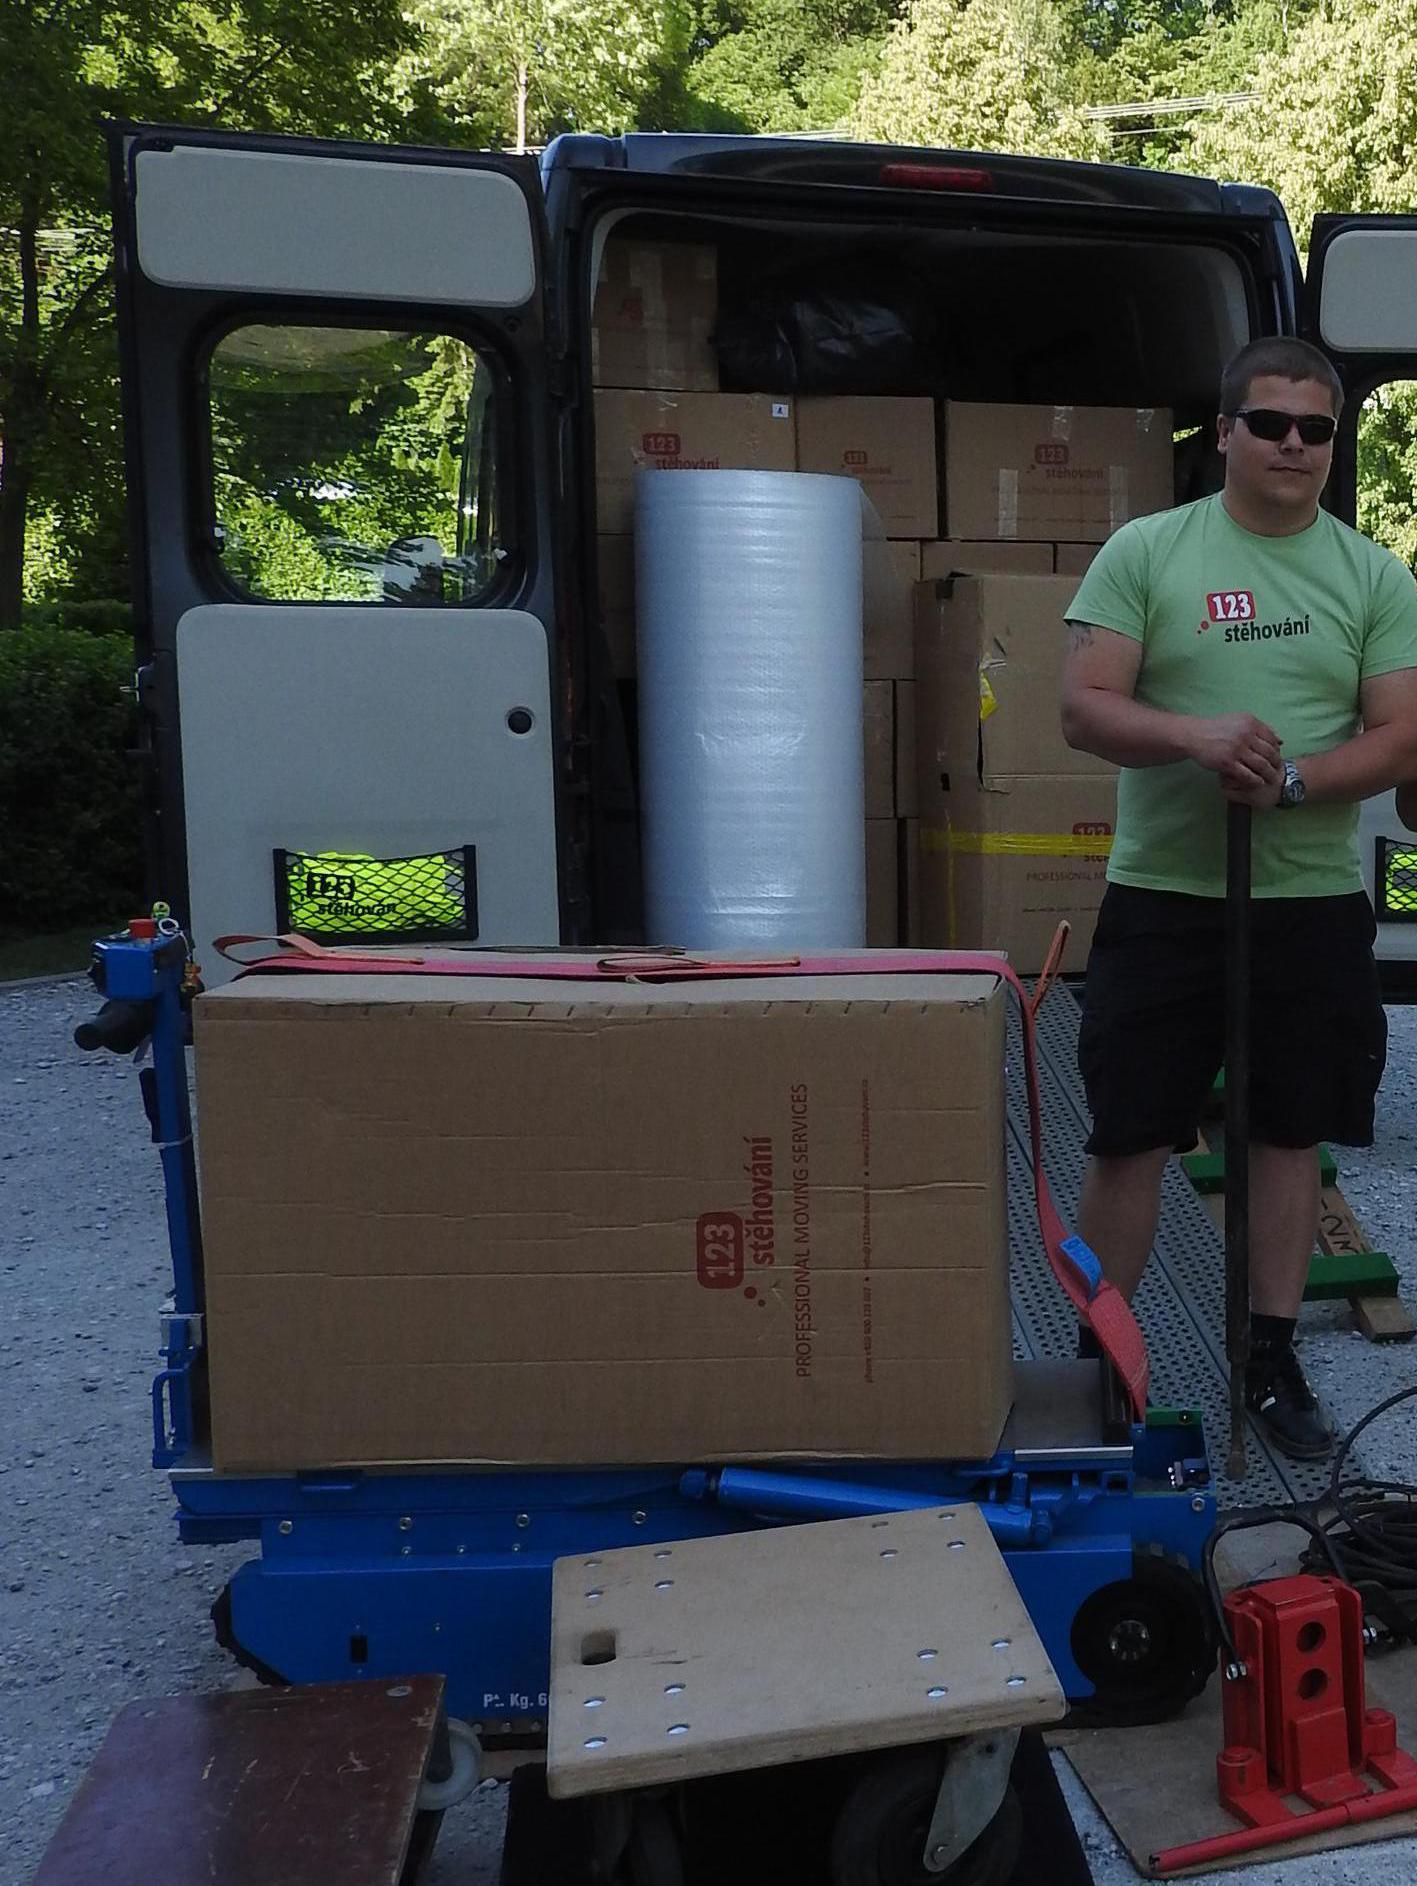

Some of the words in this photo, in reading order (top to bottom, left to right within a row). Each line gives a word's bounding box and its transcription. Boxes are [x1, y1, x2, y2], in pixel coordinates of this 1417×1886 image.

[647, 436, 676, 451] 123
[1212, 593, 1251, 619] 123
[1224, 614, 1310, 642] stěhování
[790, 1083, 809, 1164] SERVICES
[742, 1136, 775, 1266] stěhování
[791, 1168, 810, 1244] MOVING
[703, 1223, 736, 1279] 123
[793, 1250, 813, 1378] PROFESSIONAL
[510, 1692, 534, 1710] Kg.
